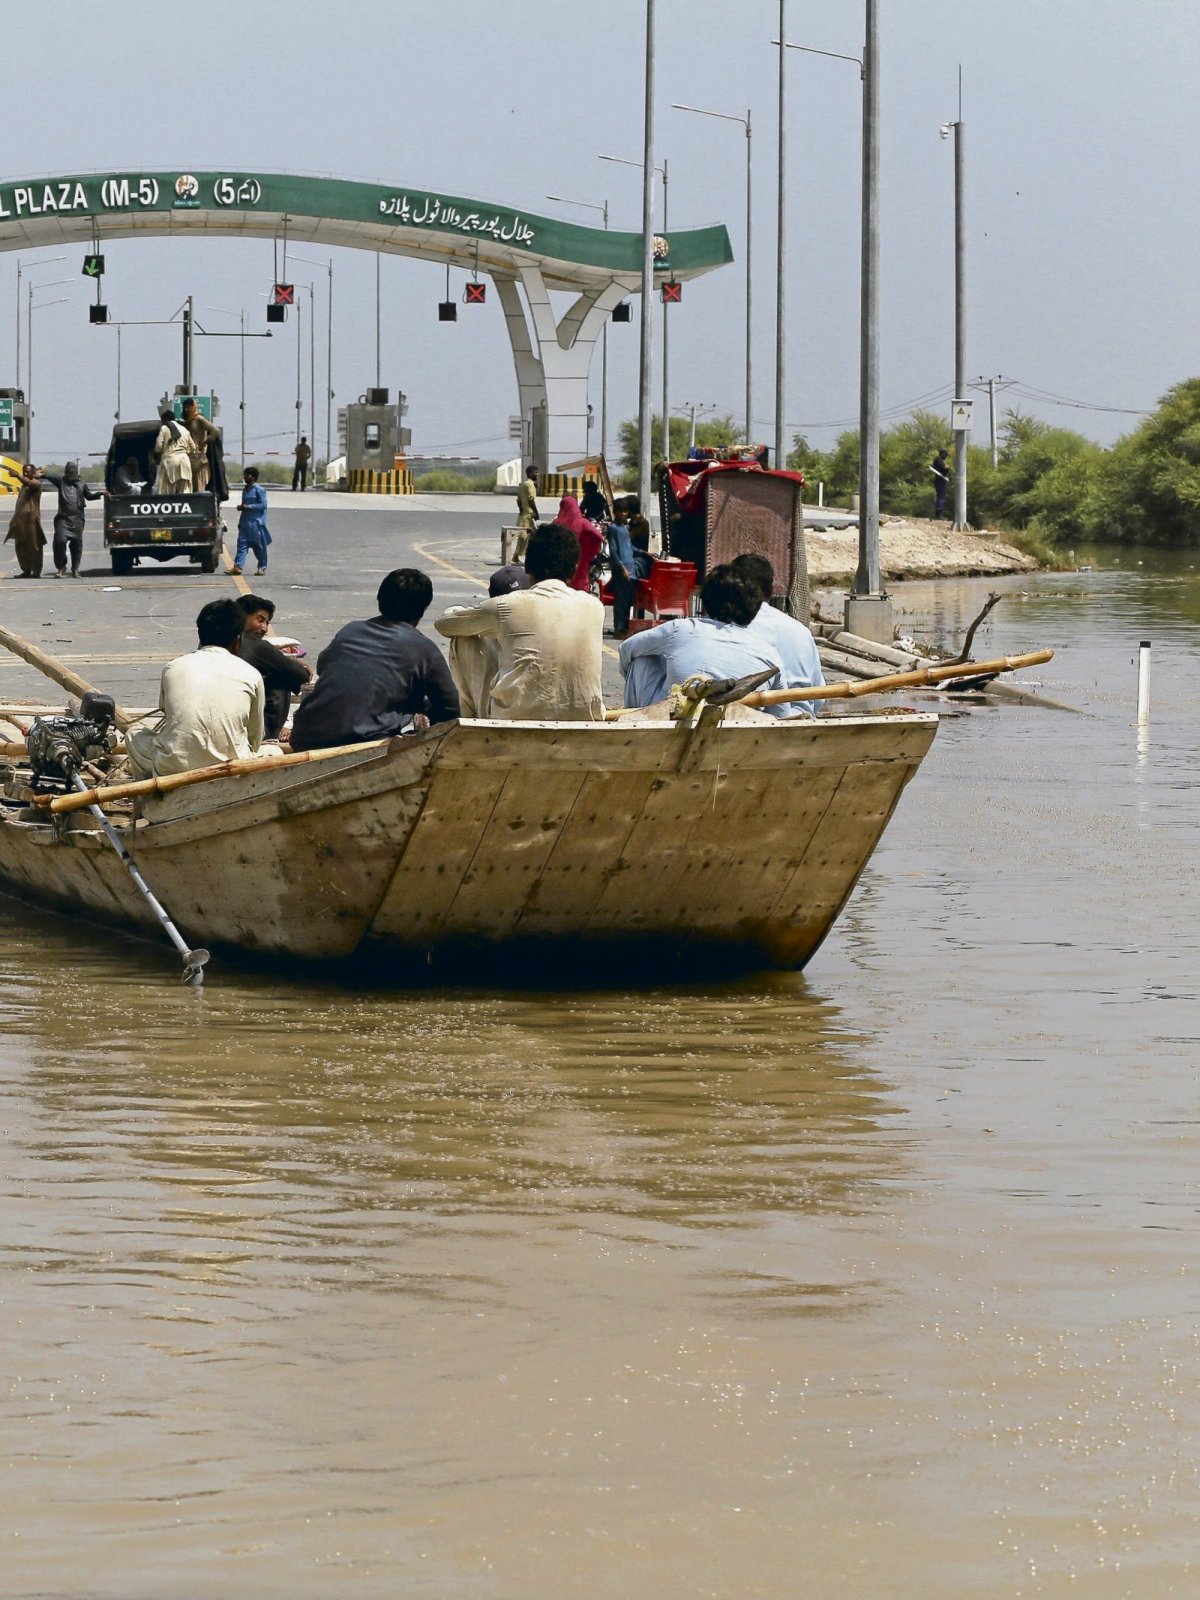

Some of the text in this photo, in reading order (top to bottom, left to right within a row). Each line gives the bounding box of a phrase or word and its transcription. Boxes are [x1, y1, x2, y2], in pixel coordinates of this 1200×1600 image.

[14, 182, 89, 214] PLAZA
[101, 178, 159, 207] (M-5)
[412, 199, 440, 223] ٹول
[501, 216, 535, 245] جلال
[130, 502, 193, 515] TOYOTA
